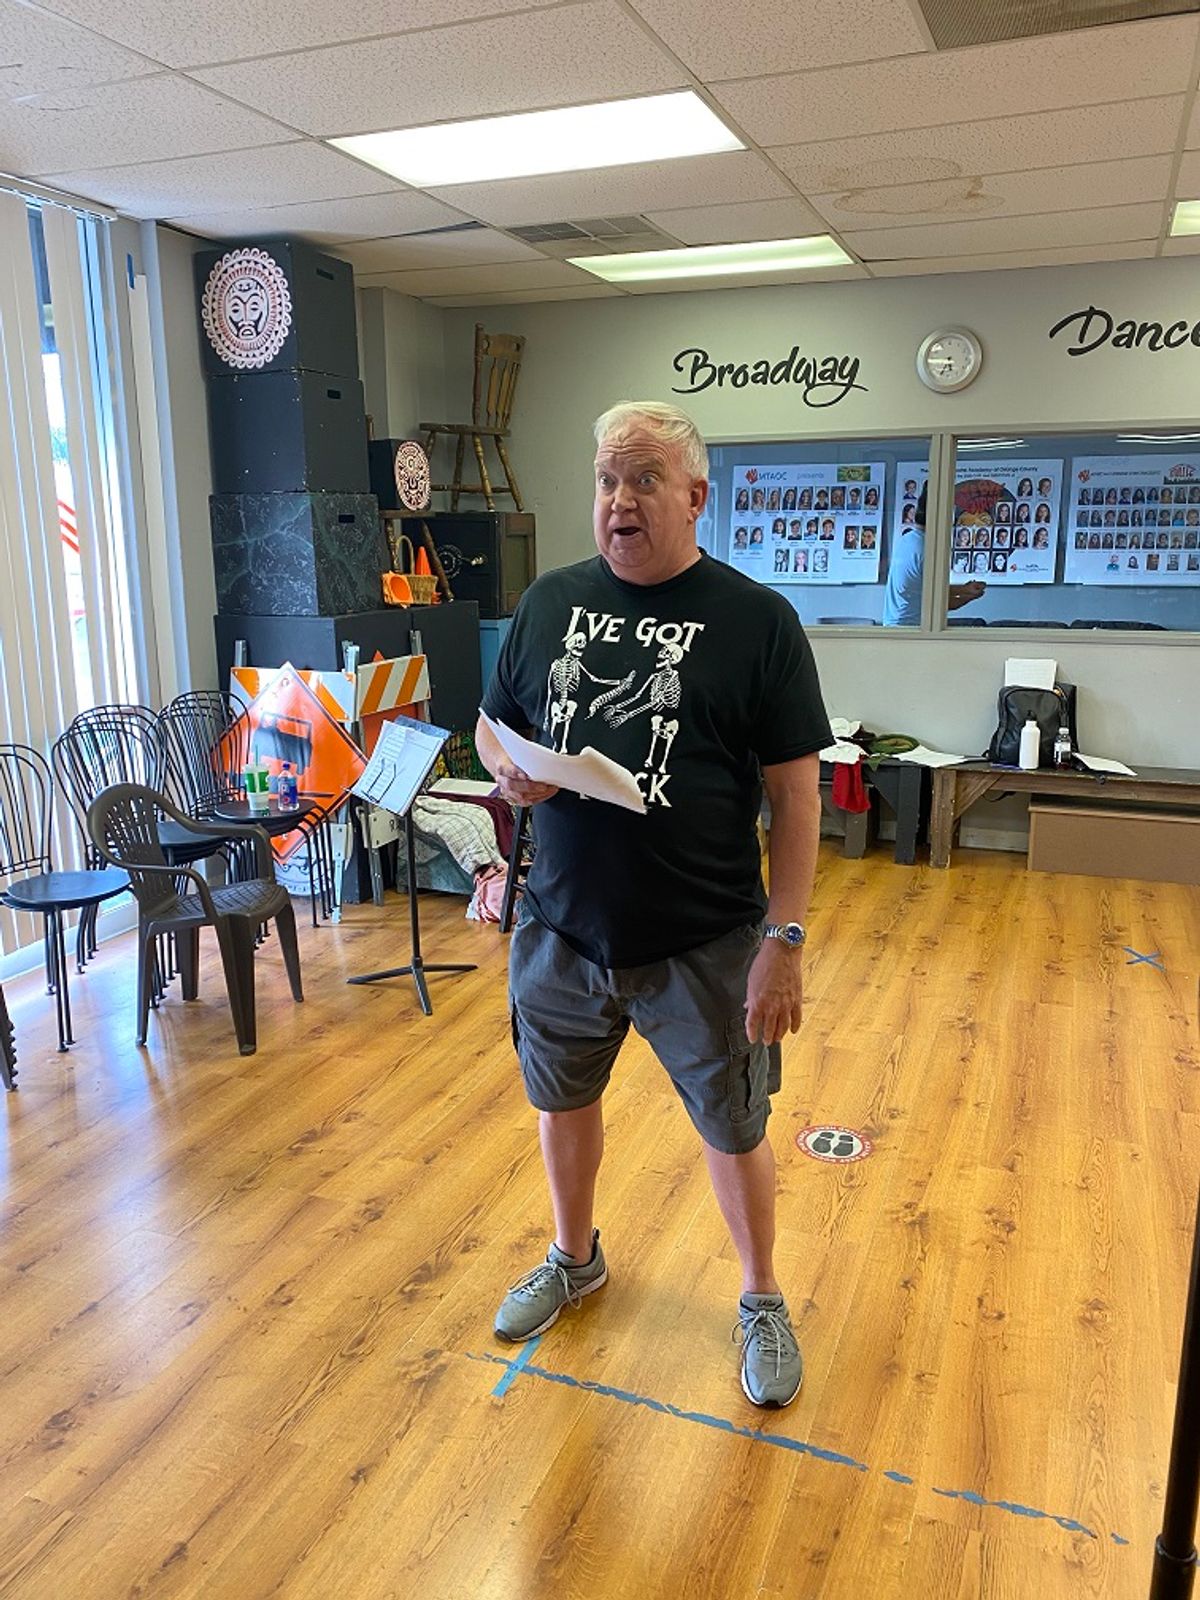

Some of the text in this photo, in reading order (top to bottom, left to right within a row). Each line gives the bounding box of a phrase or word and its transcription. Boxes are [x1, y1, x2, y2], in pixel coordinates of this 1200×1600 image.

[671, 346, 869, 408] Broadway
[561, 606, 705, 652] I'VE GOT
